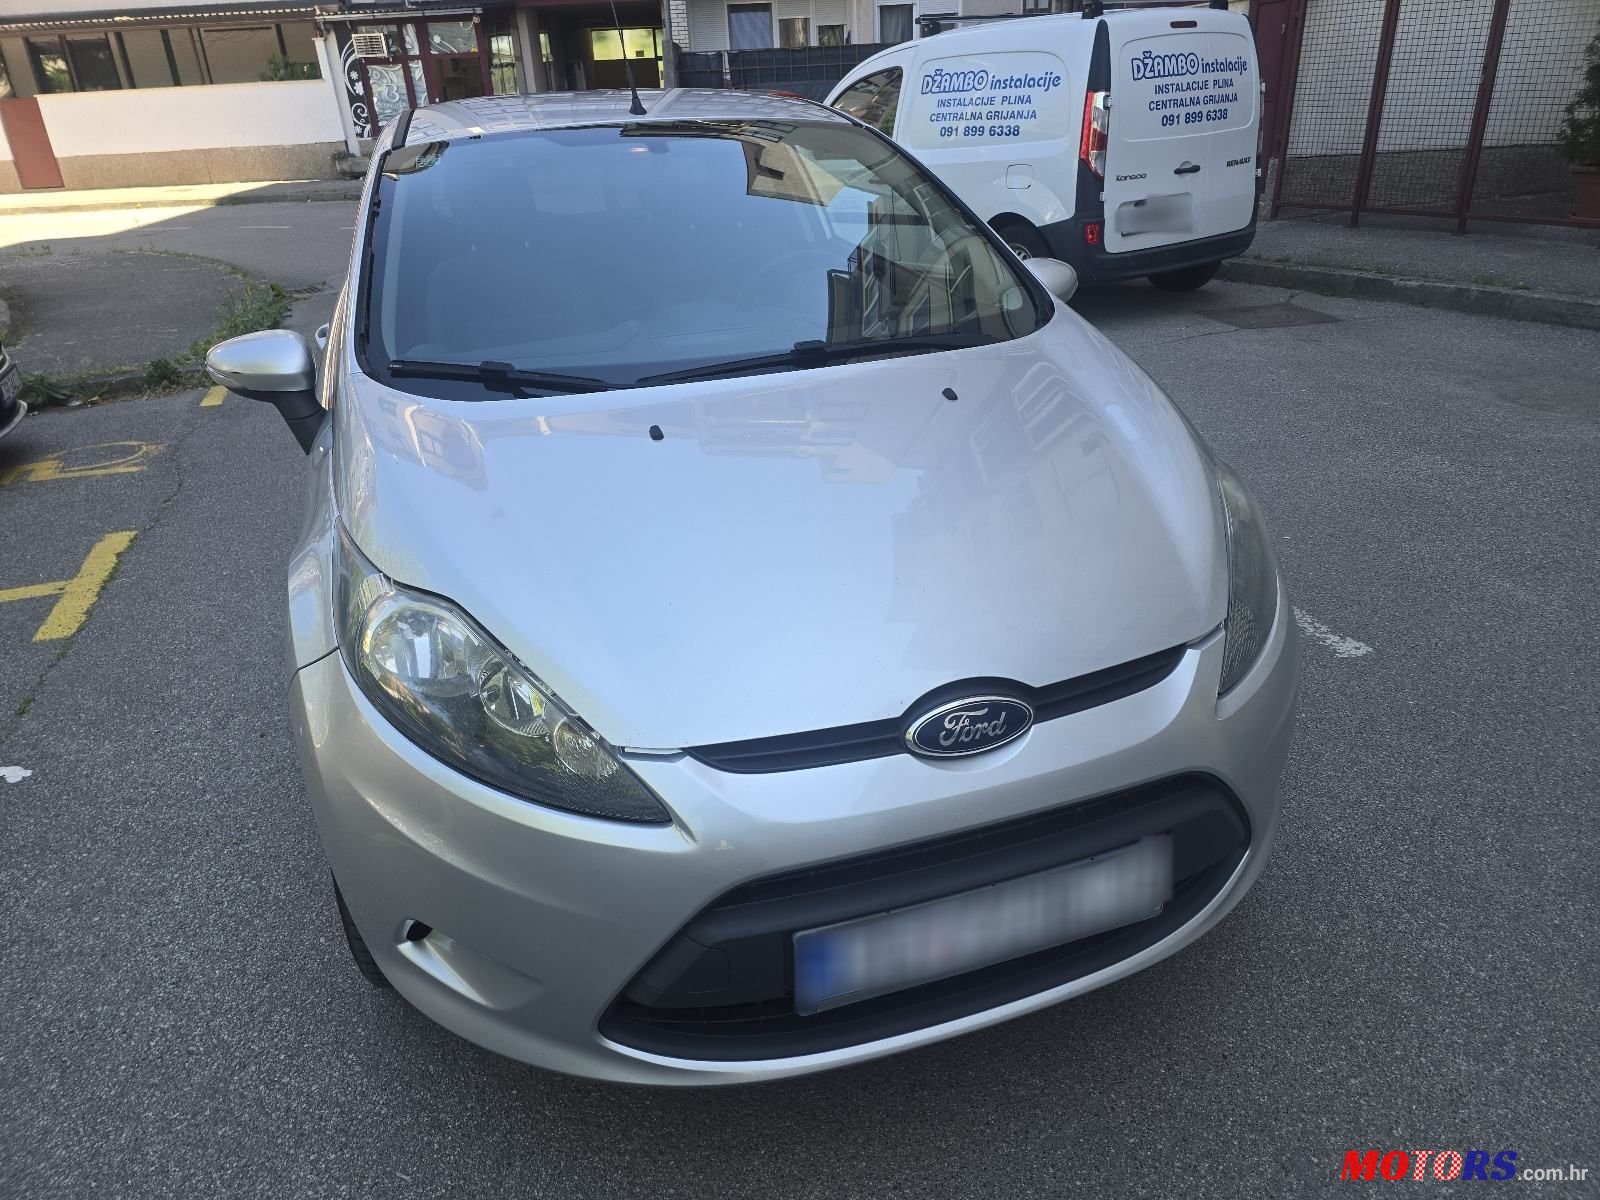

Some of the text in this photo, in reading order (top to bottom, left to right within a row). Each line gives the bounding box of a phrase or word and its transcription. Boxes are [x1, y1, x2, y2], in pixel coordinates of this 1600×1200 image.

[1131, 51, 1248, 81] DŽAMBO instalacije
[920, 69, 1062, 95] DŽAMBO instalacije
[1154, 78, 1234, 95] INSTALACIJE PLINA
[937, 94, 1032, 108] INSTALACIJE PLINA
[1148, 92, 1238, 111] CENTRALNA GRIJANJA
[929, 109, 1037, 122] CENTRALNA GRIJANJA
[1161, 108, 1229, 127] 091 899 6338
[940, 124, 1021, 137] 091 899 6338
[938, 707, 1007, 747] Ford
